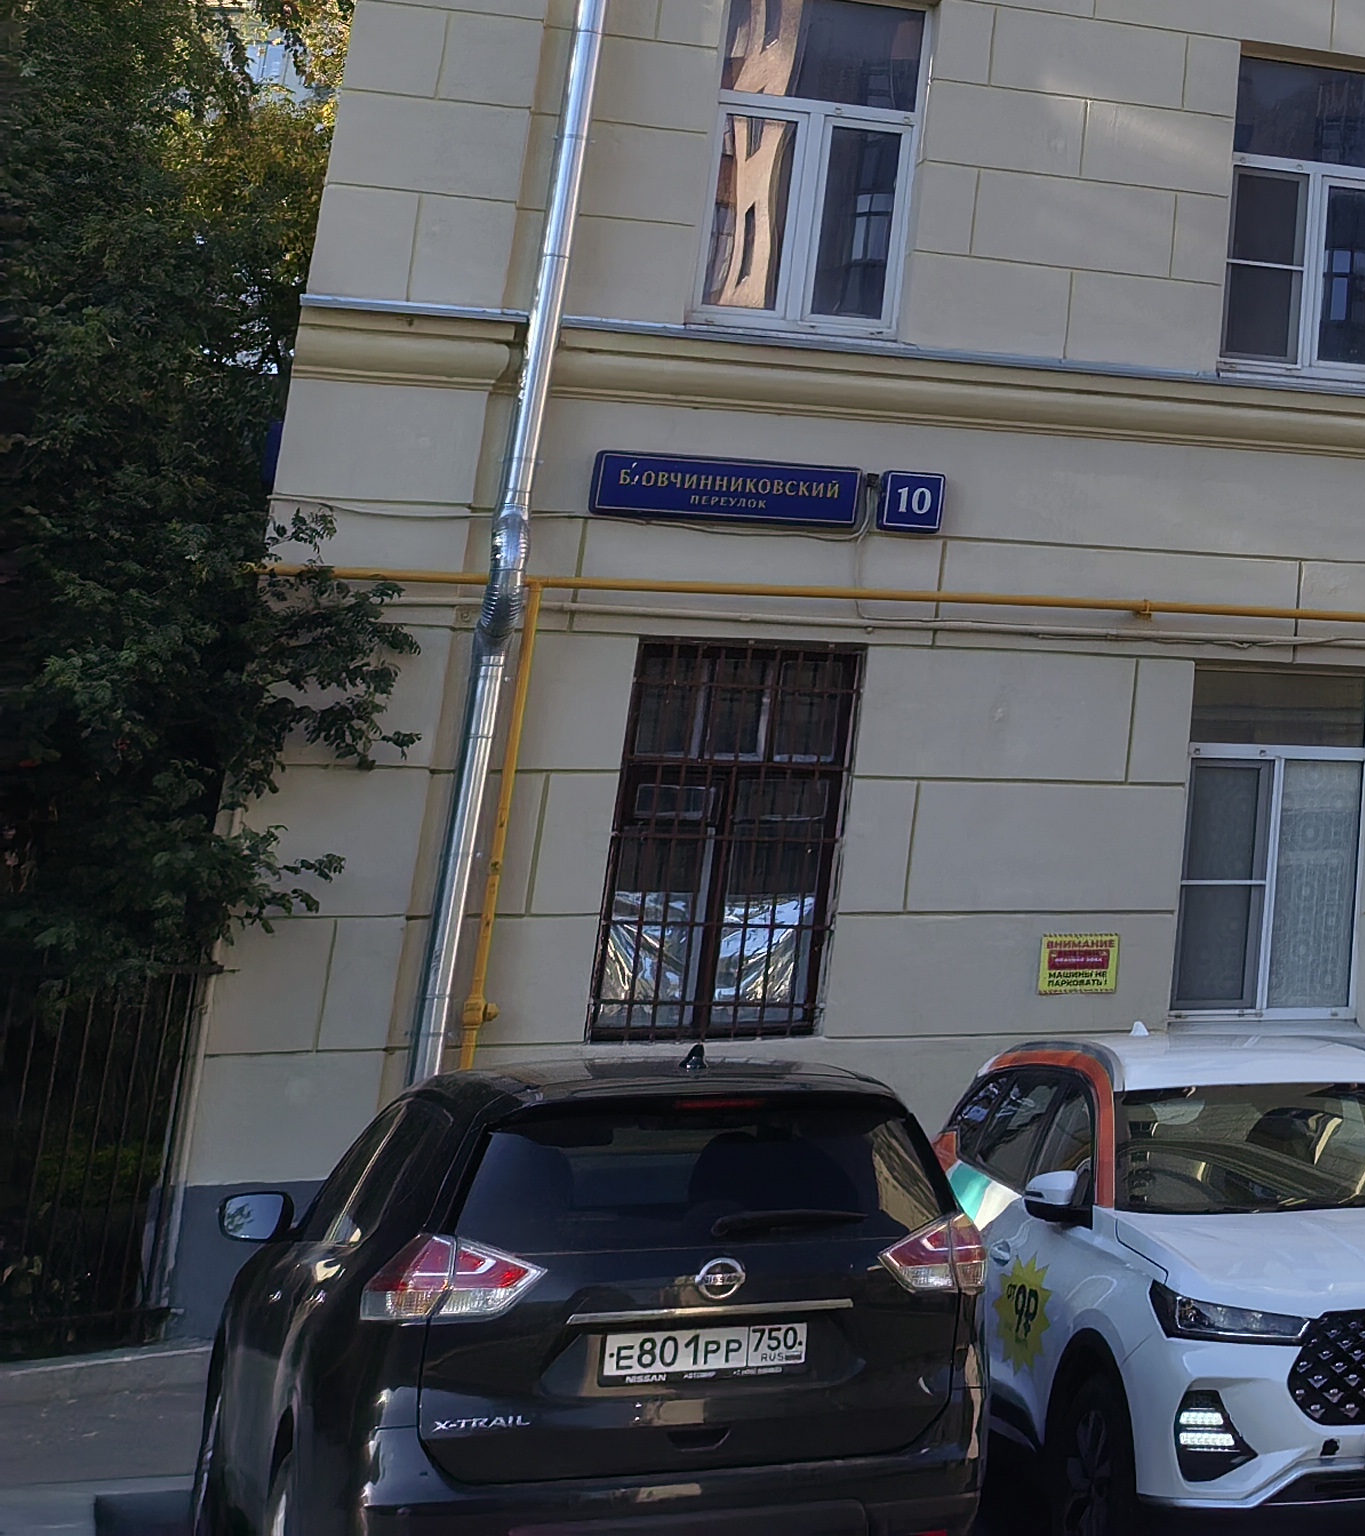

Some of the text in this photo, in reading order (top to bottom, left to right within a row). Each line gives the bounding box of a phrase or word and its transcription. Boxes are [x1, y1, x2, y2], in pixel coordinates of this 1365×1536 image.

[641, 470, 841, 499] ОВЧИННИКОВСКИЙ
[690, 494, 767, 510] ПЕРЕУЛОК
[897, 487, 933, 516] 10
[1046, 940, 1115, 949] ВНИМАНИЕ
[615, 1327, 799, 1371] Е801РР 750
[760, 1352, 784, 1362] RUS
[625, 1373, 667, 1384] NISSAN
[432, 1413, 530, 1434] X-TRAIL
